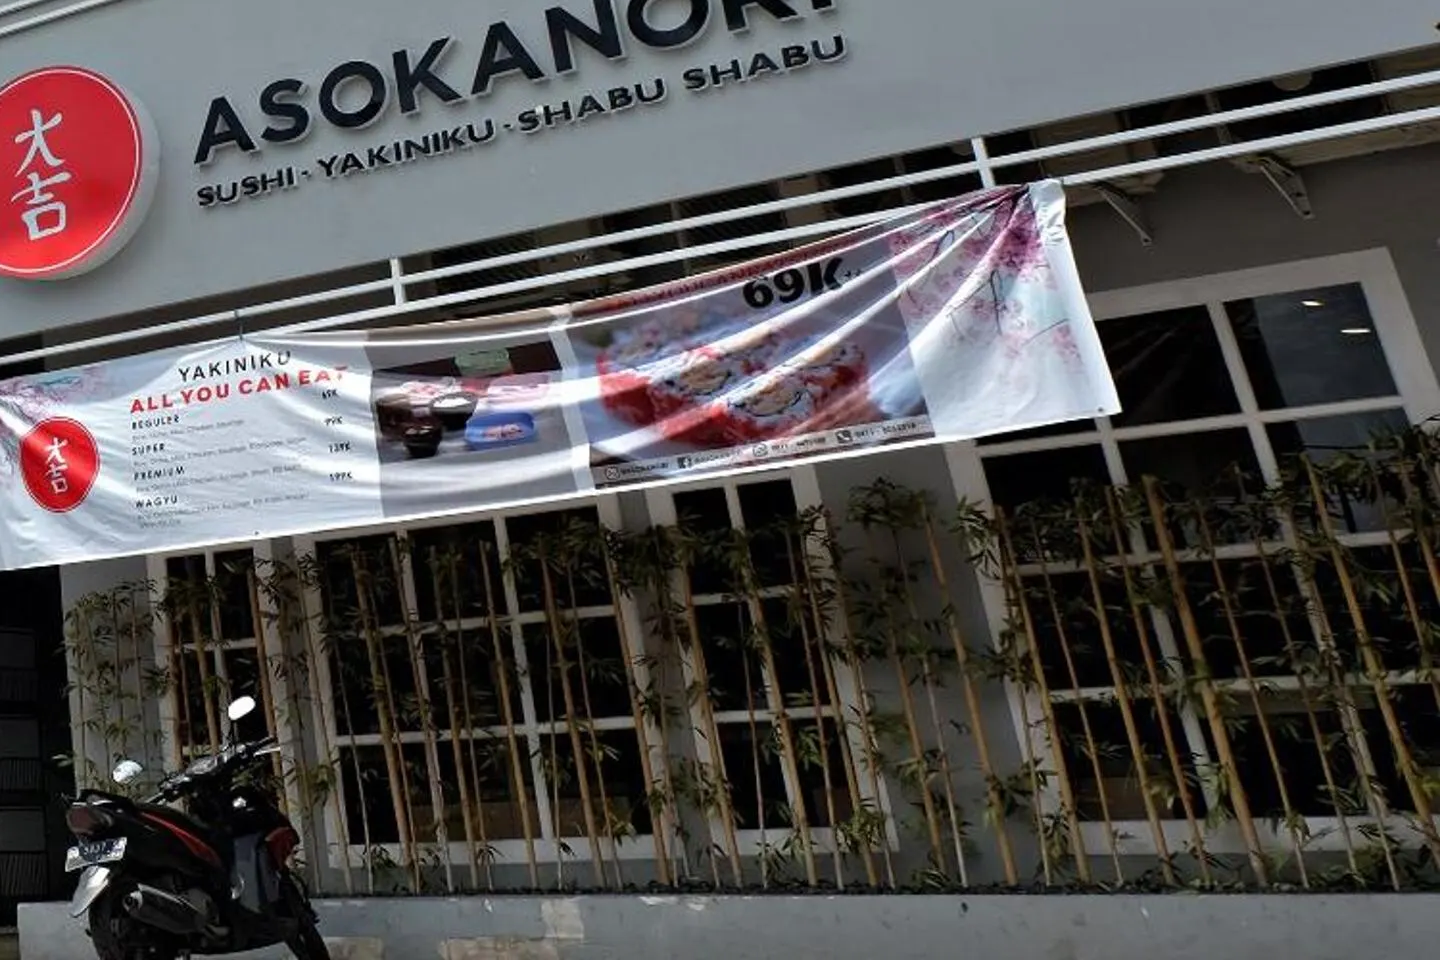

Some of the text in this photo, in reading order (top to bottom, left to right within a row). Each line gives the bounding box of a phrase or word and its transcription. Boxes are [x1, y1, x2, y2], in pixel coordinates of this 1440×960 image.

[196, 34, 846, 207] SUSHI YAKINIKU SHABU SHABU
[11, 108, 72, 241] 大吉
[178, 351, 292, 383] YAKINIKU
[130, 365, 348, 414] ALL YOU CAN EAT
[132, 443, 165, 456] SUPER
[134, 466, 185, 481] PREMIUM
[136, 495, 178, 508] WAGYU
